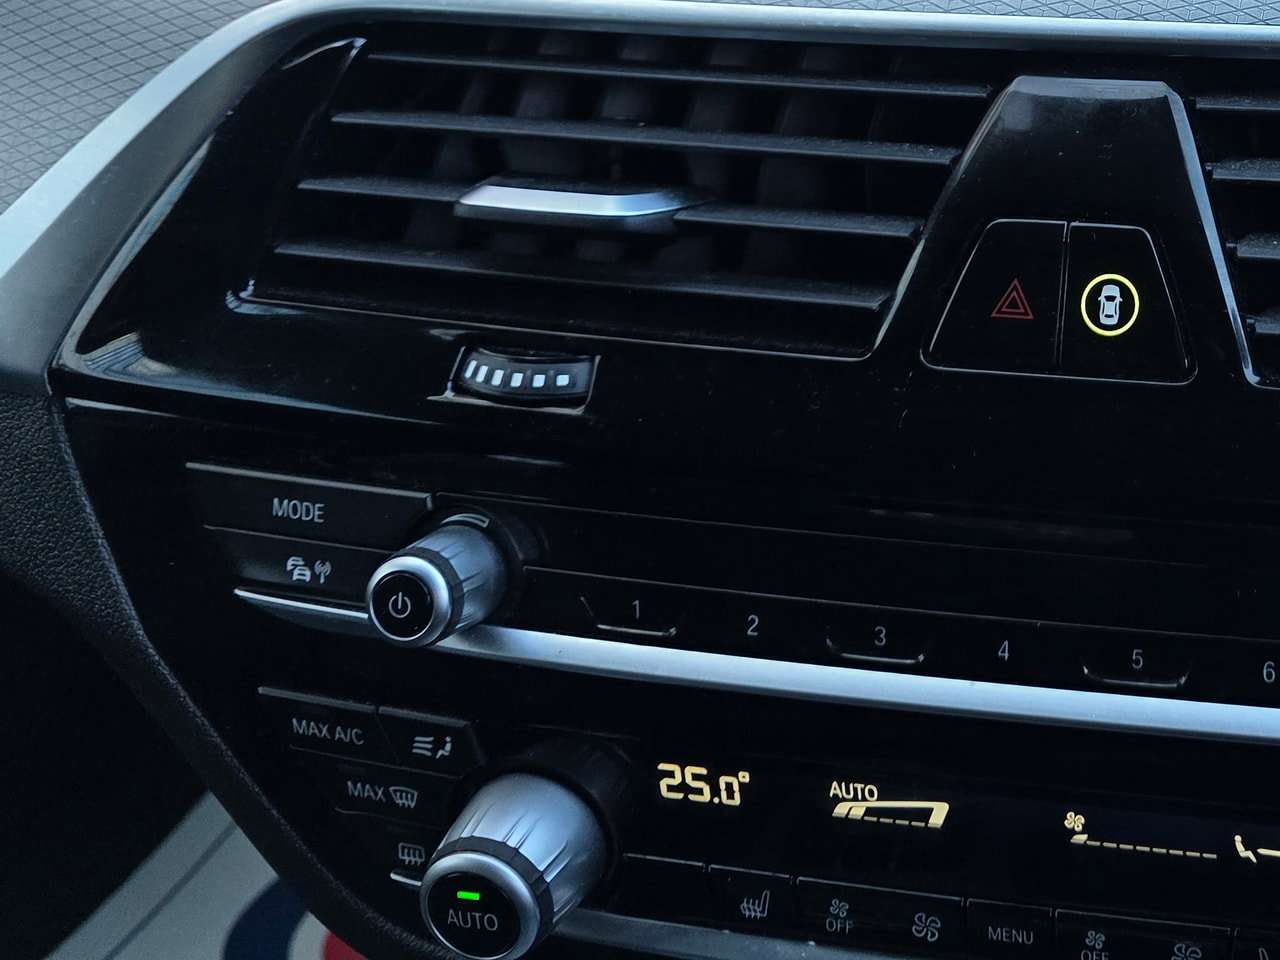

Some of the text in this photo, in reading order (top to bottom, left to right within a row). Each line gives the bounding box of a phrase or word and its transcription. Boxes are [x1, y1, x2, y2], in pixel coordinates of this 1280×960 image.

[272, 497, 325, 523] MODE
[632, 599, 640, 619] 1
[746, 614, 759, 636] 2
[874, 625, 887, 646] 3
[997, 639, 1009, 661] 4
[1131, 648, 1144, 670] 5
[1262, 660, 1276, 683] 6
[291, 717, 365, 745] MAX A/C
[346, 780, 386, 802] MAX
[829, 780, 879, 802] AUTO
[447, 908, 499, 931] AUTO
[825, 918, 853, 934] OFF
[988, 925, 1034, 945] MENU
